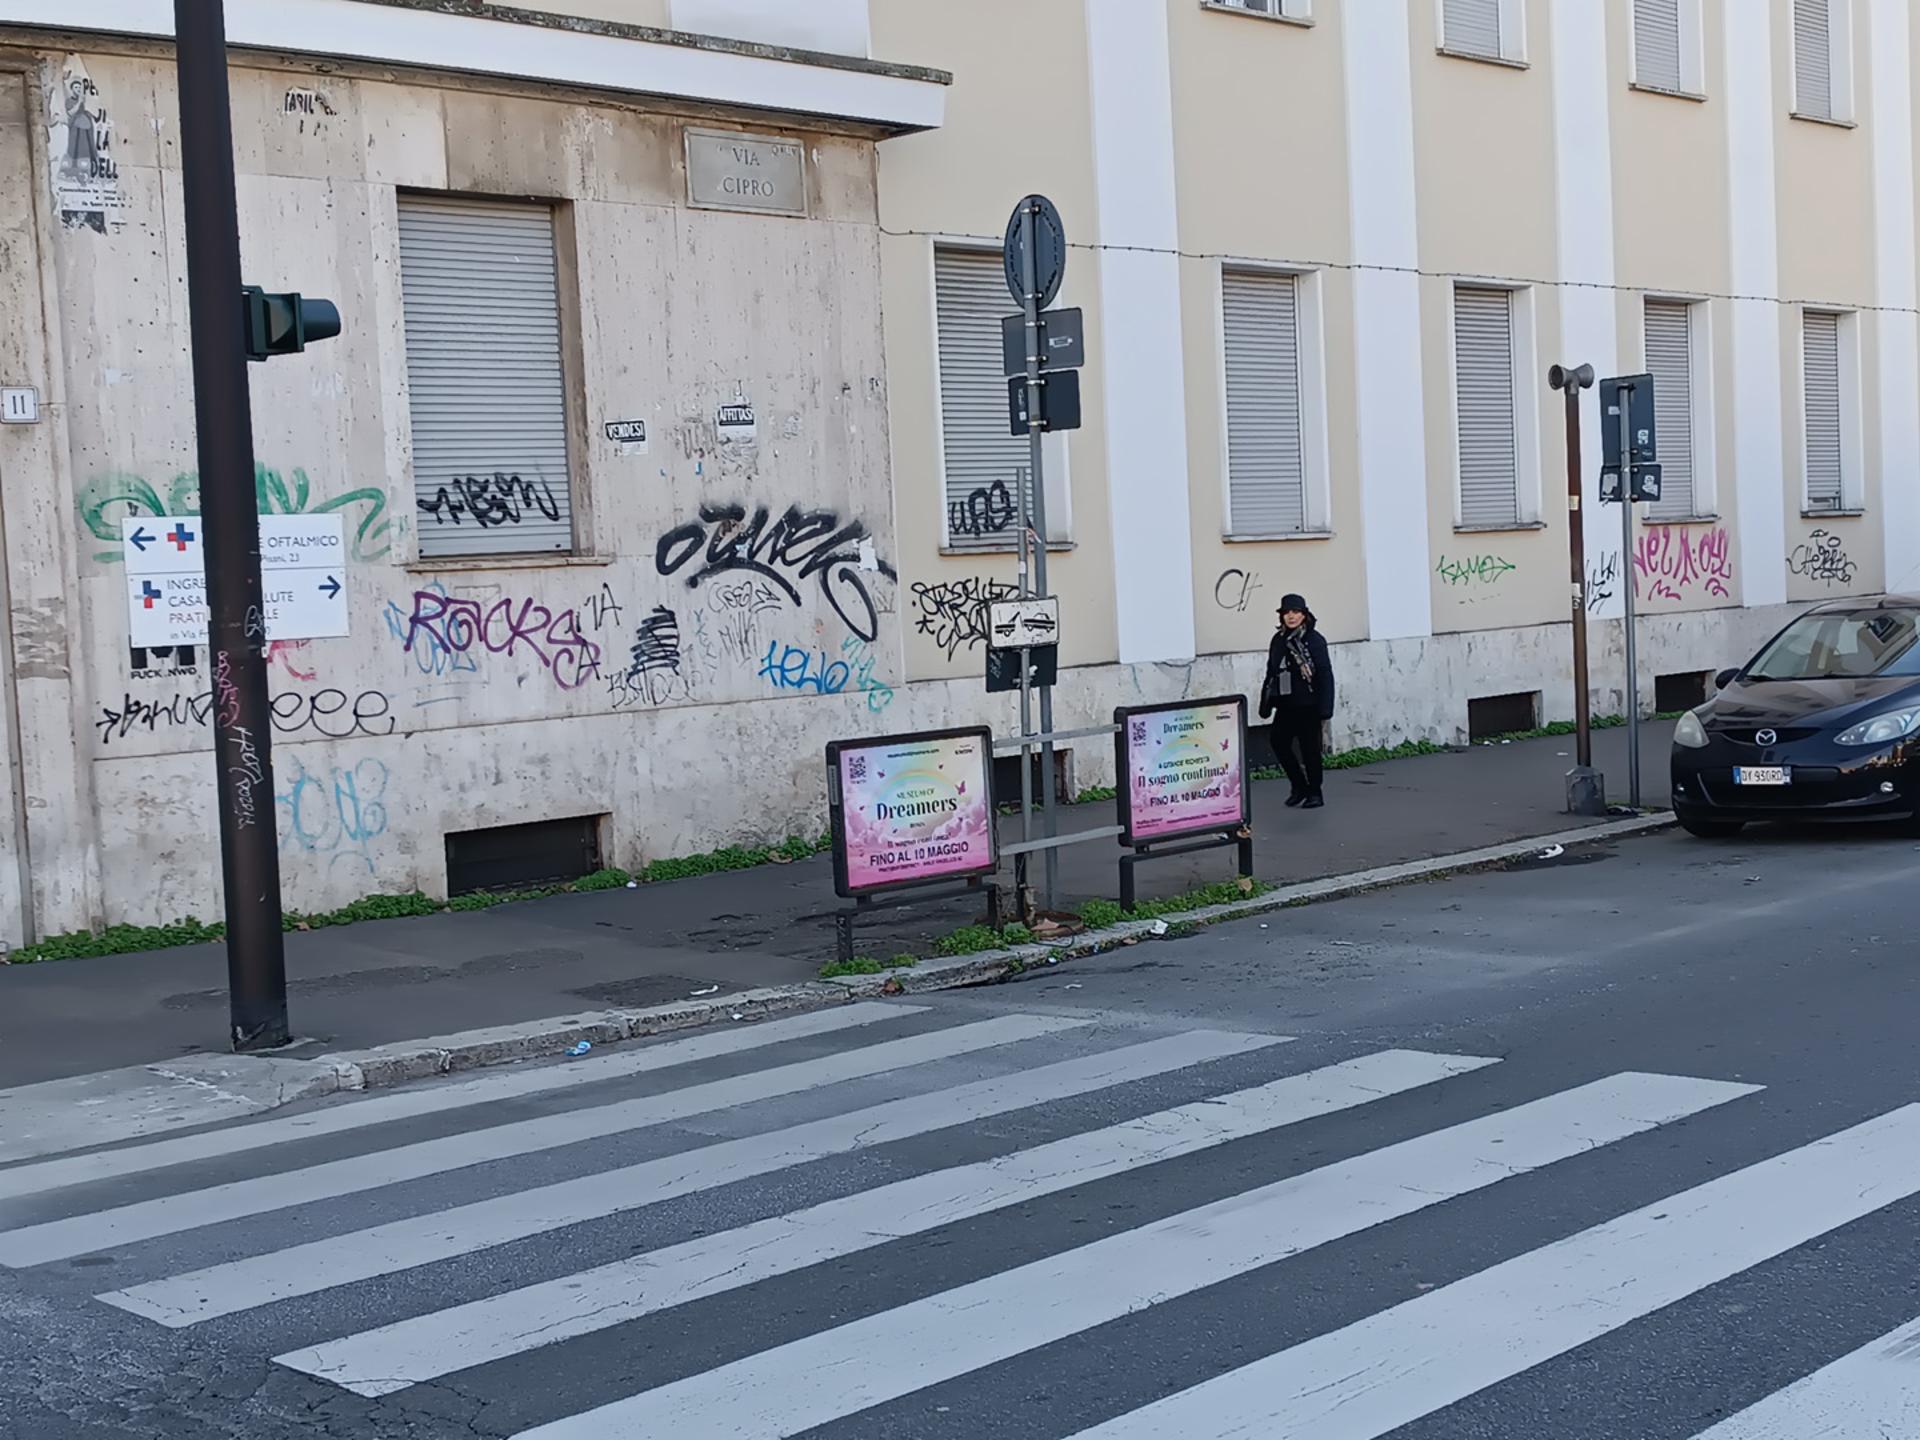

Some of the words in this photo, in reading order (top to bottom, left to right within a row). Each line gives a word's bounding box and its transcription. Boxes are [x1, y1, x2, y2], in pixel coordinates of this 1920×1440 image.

[732, 146, 761, 167] VIA
[723, 176, 775, 198] CIPRO
[12, 395, 26, 415] 11
[606, 422, 644, 438] VENDESI
[267, 535, 339, 549] OFTALMICO
[168, 595, 204, 608] CASA
[1148, 773, 1179, 786] sogno
[1181, 763, 1229, 782] continua!
[1150, 795, 1169, 807] FINO
[1170, 794, 1180, 803] AL
[1181, 792, 1190, 802] 10
[1191, 787, 1220, 801] MAGGIO
[876, 797, 958, 821] Dreamers
[870, 851, 895, 866] FINO
[897, 850, 911, 863] AL
[915, 848, 925, 860] 10
[928, 841, 969, 858] MAGGIO
